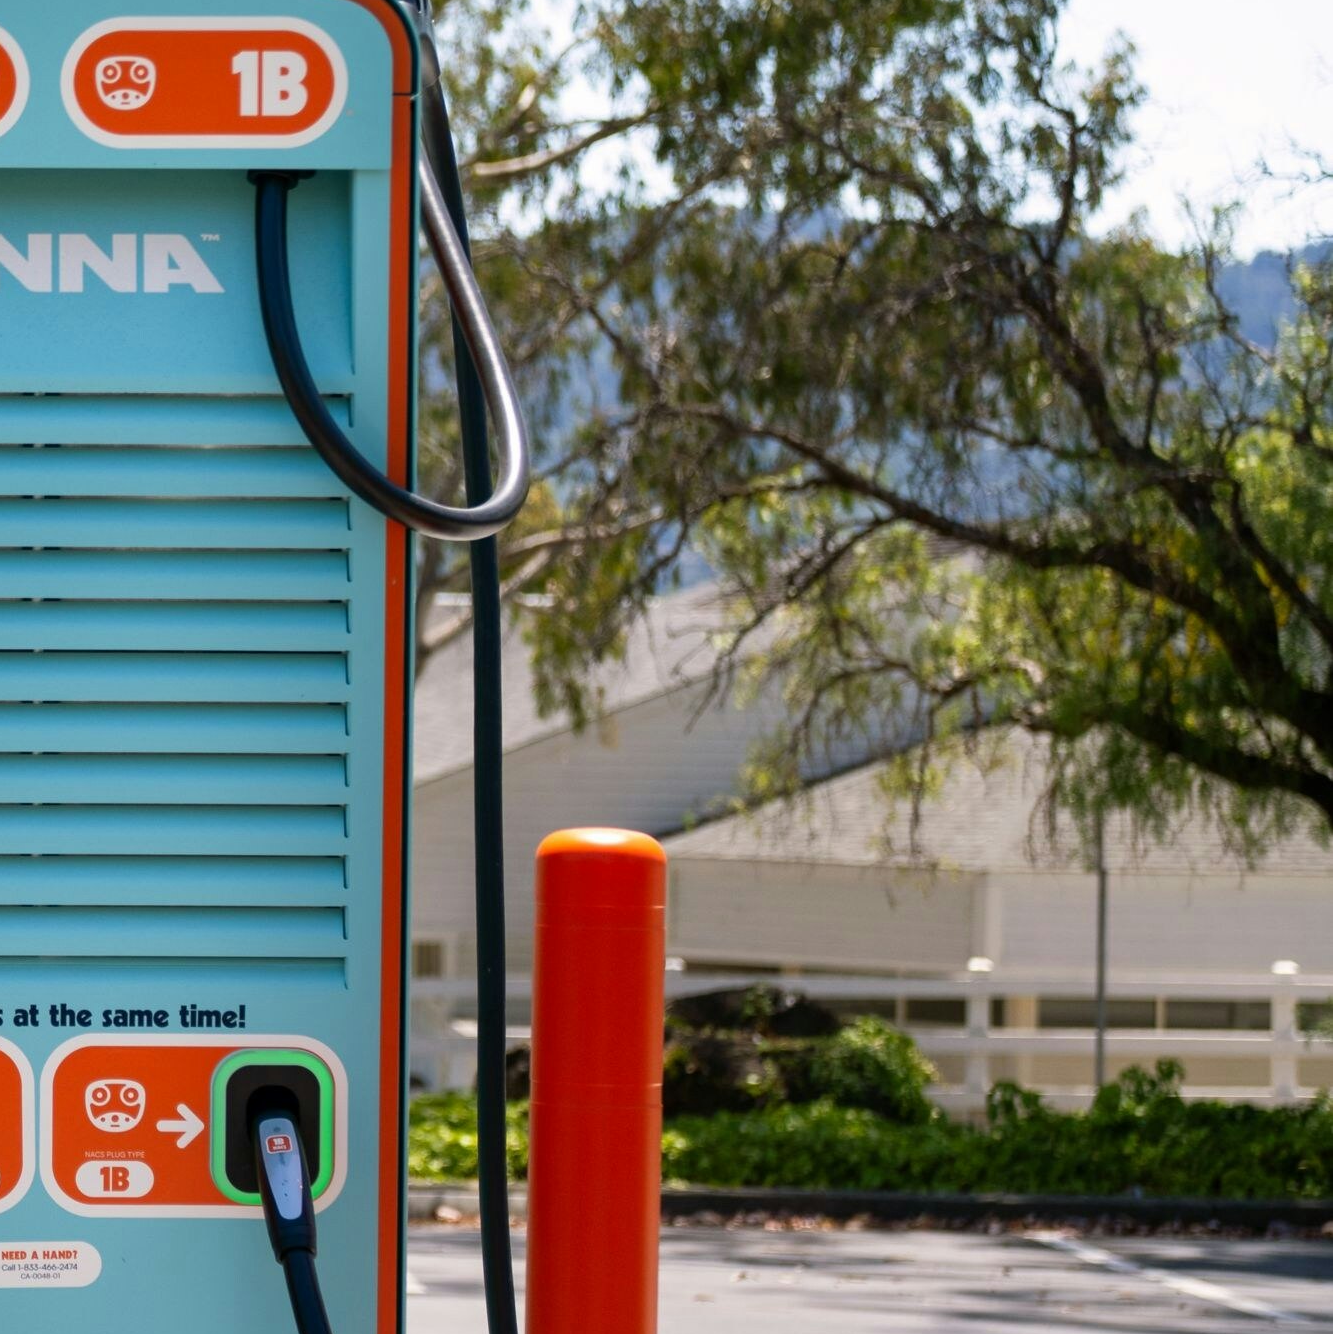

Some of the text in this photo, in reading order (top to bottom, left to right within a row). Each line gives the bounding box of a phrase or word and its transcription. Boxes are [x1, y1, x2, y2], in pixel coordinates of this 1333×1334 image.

[232, 51, 308, 117] 1B
[13, 1005, 39, 1027] at
[49, 1003, 92, 1027] the
[102, 1008, 169, 1028] same
[179, 1004, 246, 1028] time!
[273, 1137, 285, 1145] 1B
[85, 1151, 145, 1159] NACS PLUG TYPE
[100, 1166, 130, 1192] 1B
[1, 1250, 78, 1260] NEED A HAND?
[1, 1264, 15, 1272] Call
